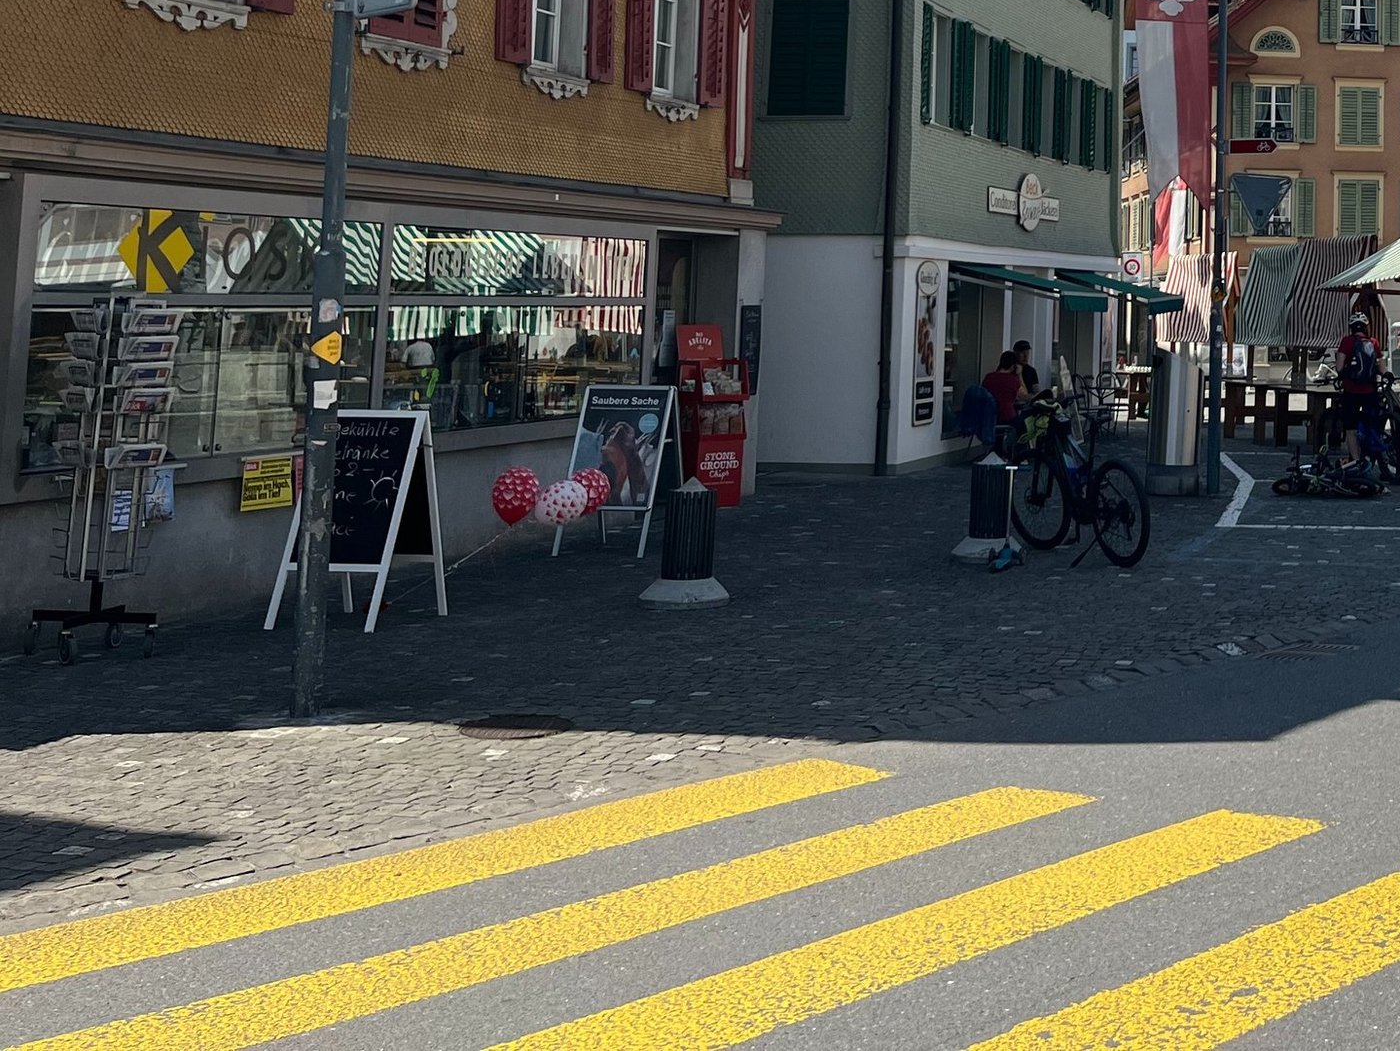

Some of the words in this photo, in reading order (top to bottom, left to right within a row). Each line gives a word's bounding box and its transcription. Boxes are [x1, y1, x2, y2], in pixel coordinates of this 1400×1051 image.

[591, 396, 630, 406] Saubere
[631, 396, 660, 406] Sache
[335, 441, 390, 461] etränke
[704, 451, 737, 461] STONE
[700, 460, 740, 470] GROUND
[708, 469, 730, 481] Chips
